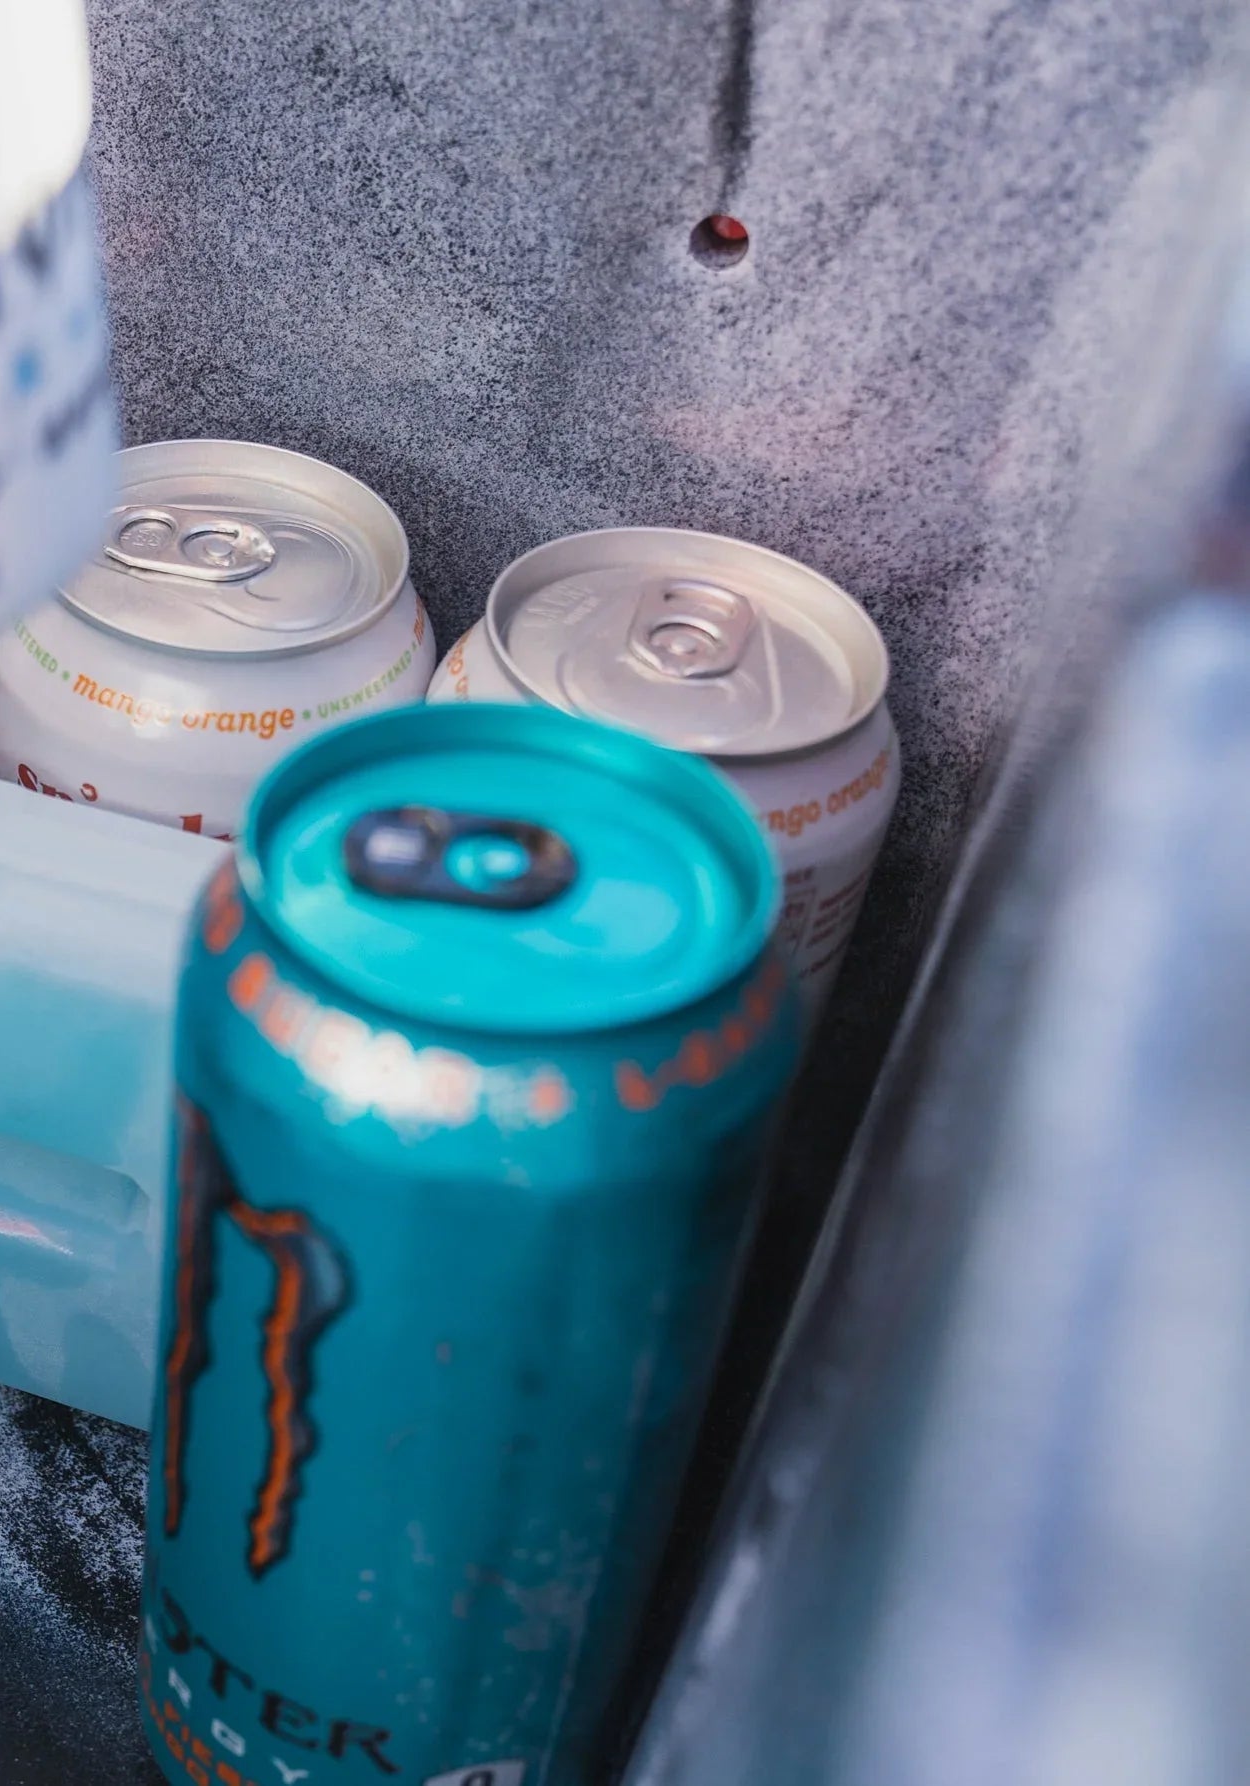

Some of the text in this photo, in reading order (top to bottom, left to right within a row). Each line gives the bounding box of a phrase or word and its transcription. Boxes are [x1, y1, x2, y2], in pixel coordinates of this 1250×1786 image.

[72, 672, 173, 727] mango
[181, 708, 296, 740] orange
[316, 648, 414, 720] UNSWEETENED
[755, 796, 822, 839] ngo
